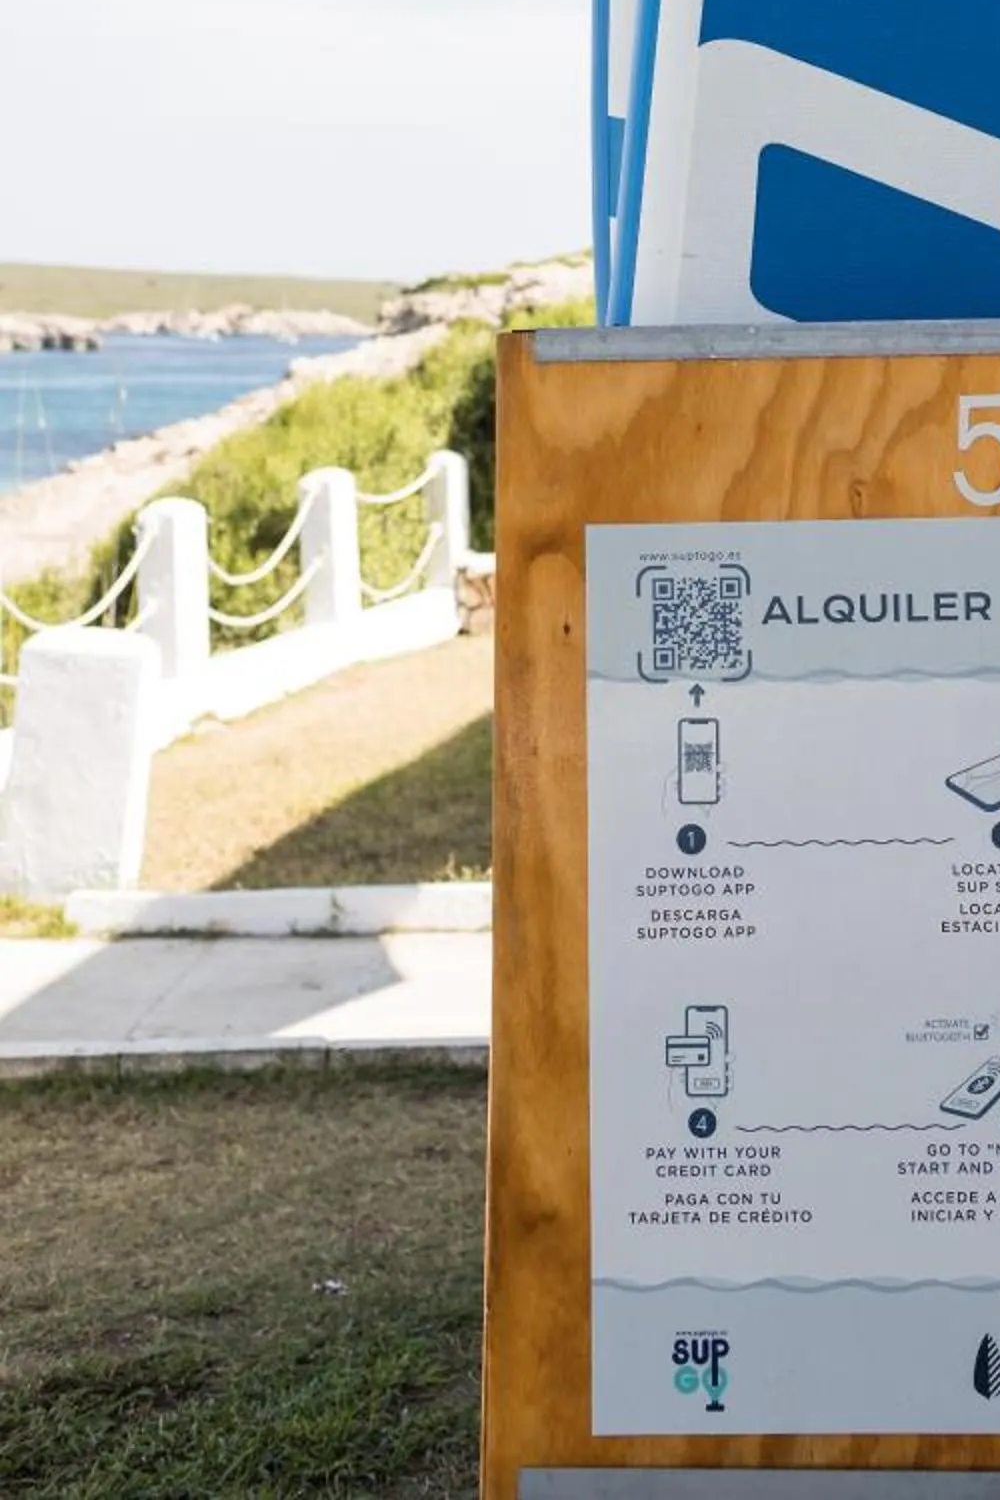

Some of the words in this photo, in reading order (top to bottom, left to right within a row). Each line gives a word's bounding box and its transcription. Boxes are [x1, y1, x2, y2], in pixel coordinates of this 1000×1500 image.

[762, 591, 991, 624] ALQUILER
[645, 866, 745, 879] DOWNLOAD
[636, 884, 715, 897] SUPTOGO
[723, 883, 755, 896] APP
[957, 881, 988, 893] SUP
[650, 909, 742, 922] DESCARGA
[637, 927, 716, 940] SUPTOGO
[724, 926, 757, 938] APP
[645, 1147, 677, 1160] PAY
[684, 1147, 728, 1159] WITH
[736, 1146, 782, 1159] YOUR
[927, 1143, 951, 1157] GO
[959, 1143, 981, 1156] TO
[656, 1165, 718, 1178] CREDIT
[724, 1164, 772, 1177] CARD
[897, 1162, 950, 1175] START
[957, 1162, 993, 1174] AND
[665, 1193, 710, 1206] PAGA
[717, 1193, 754, 1205] CON
[760, 1193, 782, 1205] TU
[911, 1191, 979, 1204] ACCEDE
[986, 1191, 997, 1204] A
[628, 1211, 702, 1225] TARJETA
[709, 1211, 731, 1224] DE
[737, 1207, 813, 1223] CRÉDITO
[911, 1209, 977, 1222] INICIAR
[984, 1209, 994, 1221] Y
[672, 1338, 730, 1386] SUP
